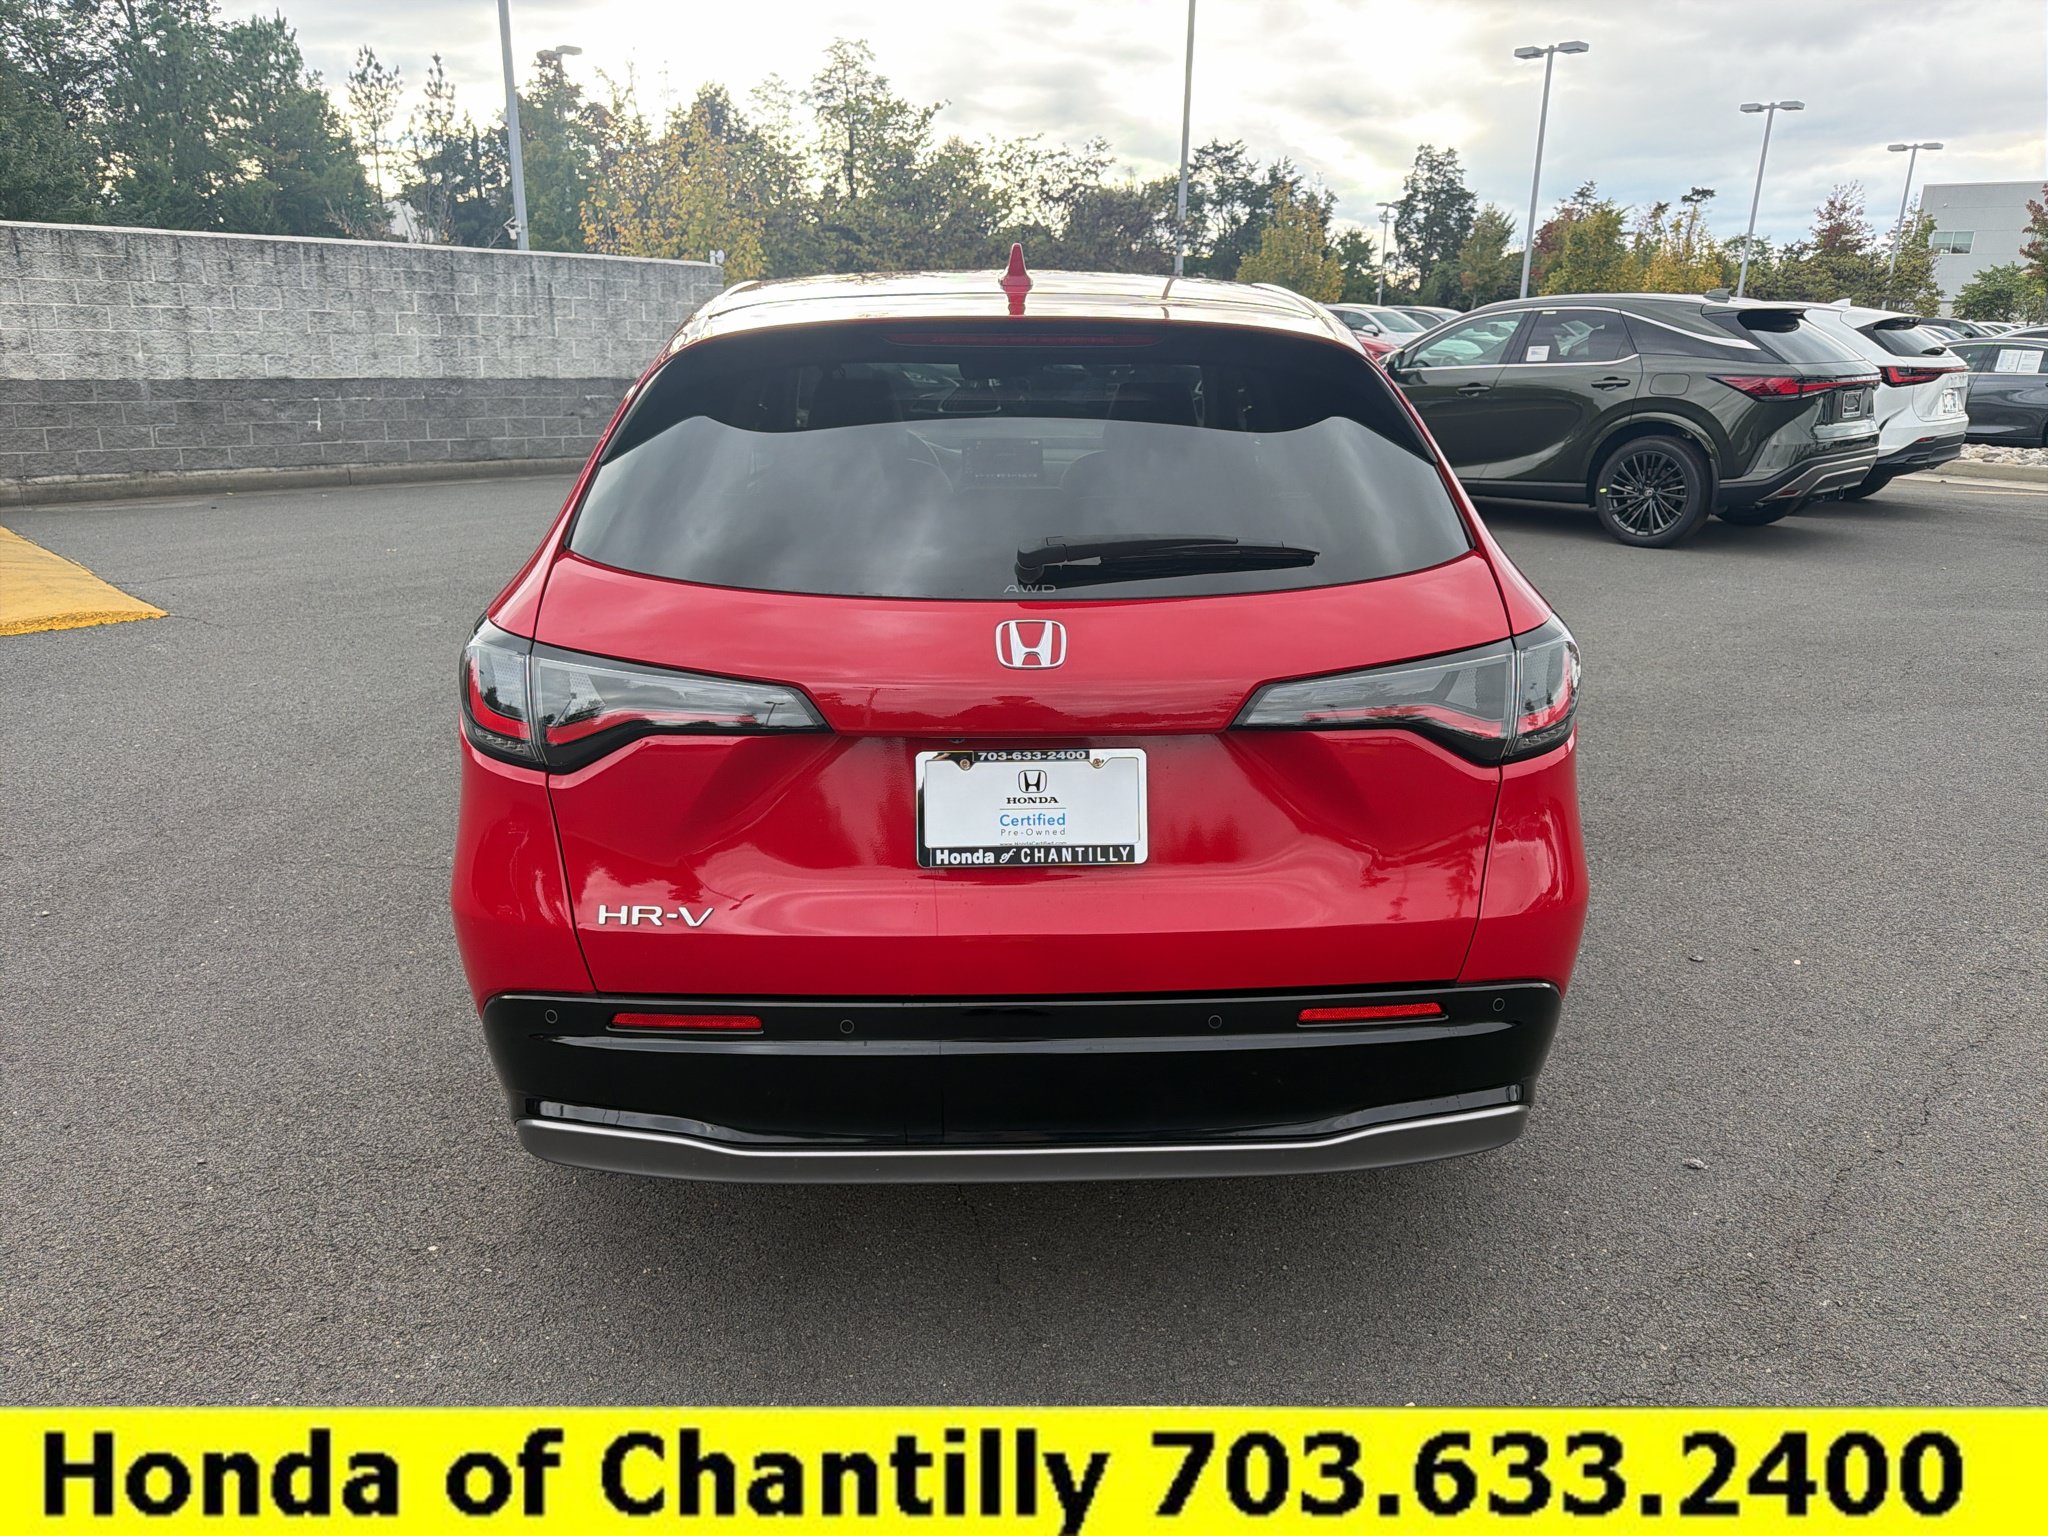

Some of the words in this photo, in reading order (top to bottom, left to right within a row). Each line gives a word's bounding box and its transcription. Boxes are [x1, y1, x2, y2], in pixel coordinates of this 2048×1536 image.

[1003, 584, 1057, 594] AWD
[977, 750, 1087, 761] 703-633-2400
[1005, 796, 1060, 805] HONDA
[999, 812, 1067, 827] Certified
[1000, 827, 1067, 837] Pre-Owned
[935, 848, 995, 865] Honda
[999, 848, 1017, 864] of
[1020, 846, 1131, 863] CHANTILLY
[597, 904, 715, 928] HR-V
